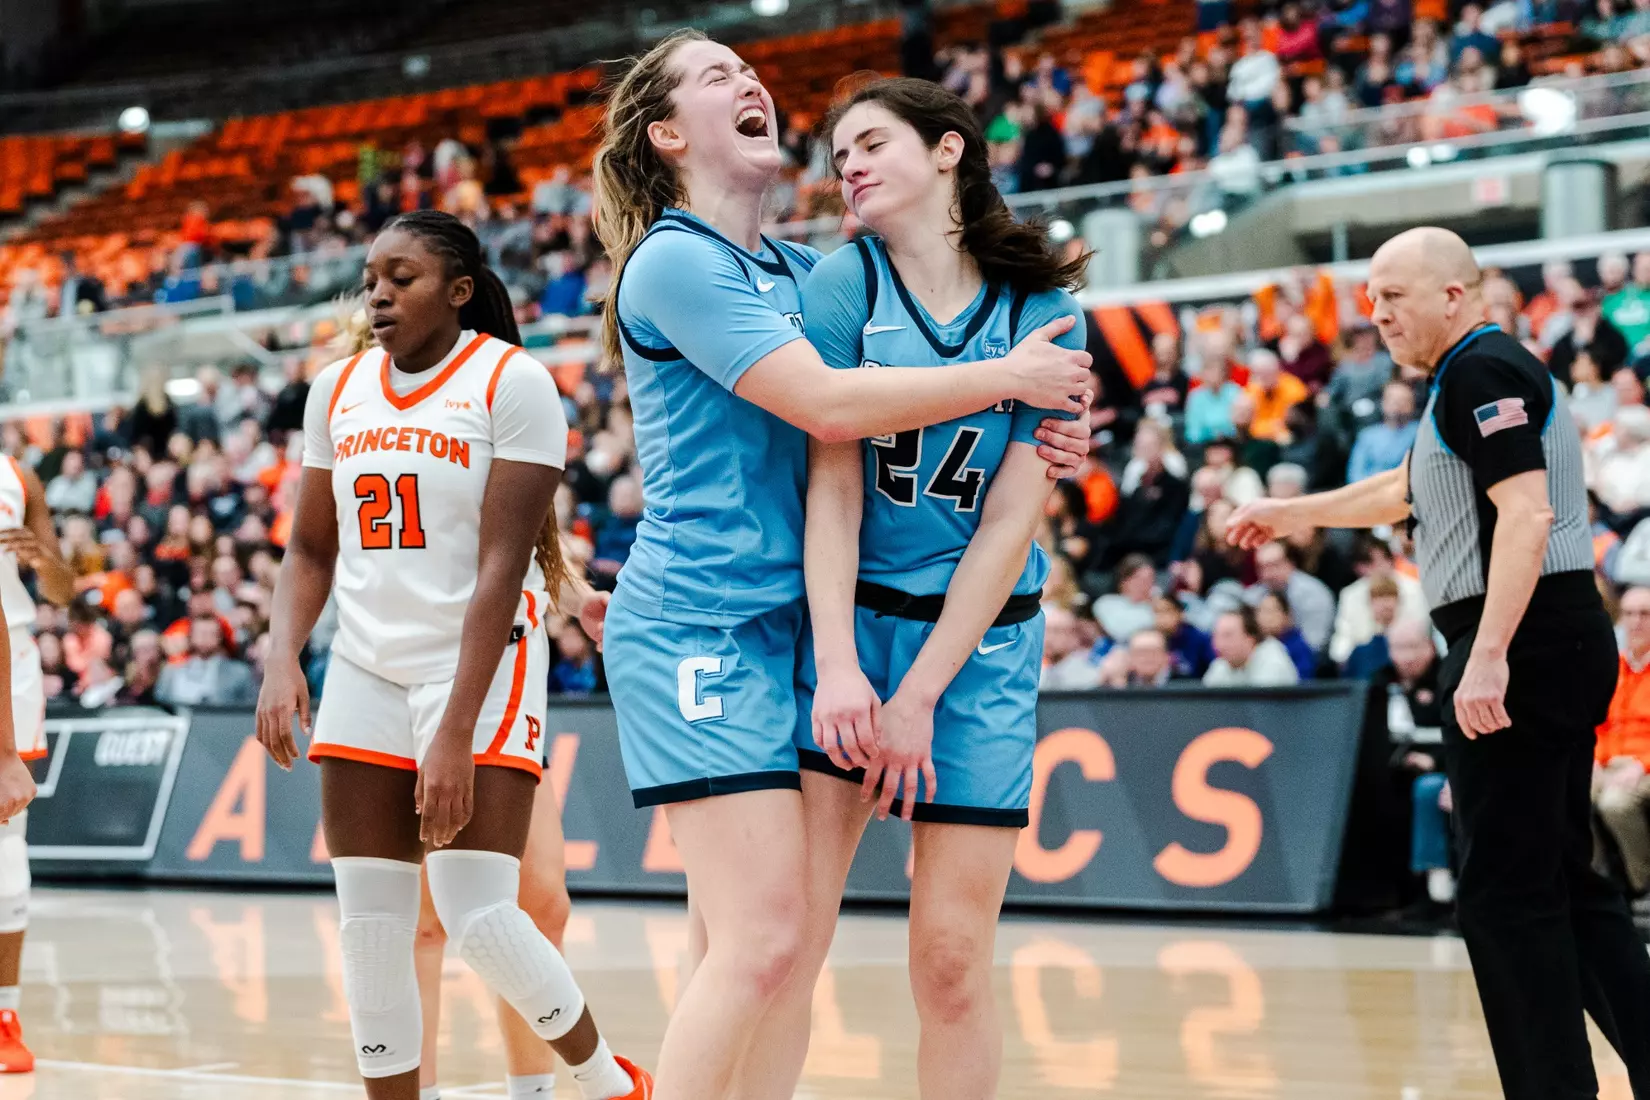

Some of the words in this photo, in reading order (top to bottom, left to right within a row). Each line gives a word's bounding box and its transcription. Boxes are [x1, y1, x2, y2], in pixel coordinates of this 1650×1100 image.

[334, 426, 470, 469] PRINCETON
[871, 426, 986, 512] 24
[353, 473, 426, 550] 21
[676, 655, 728, 725] C
